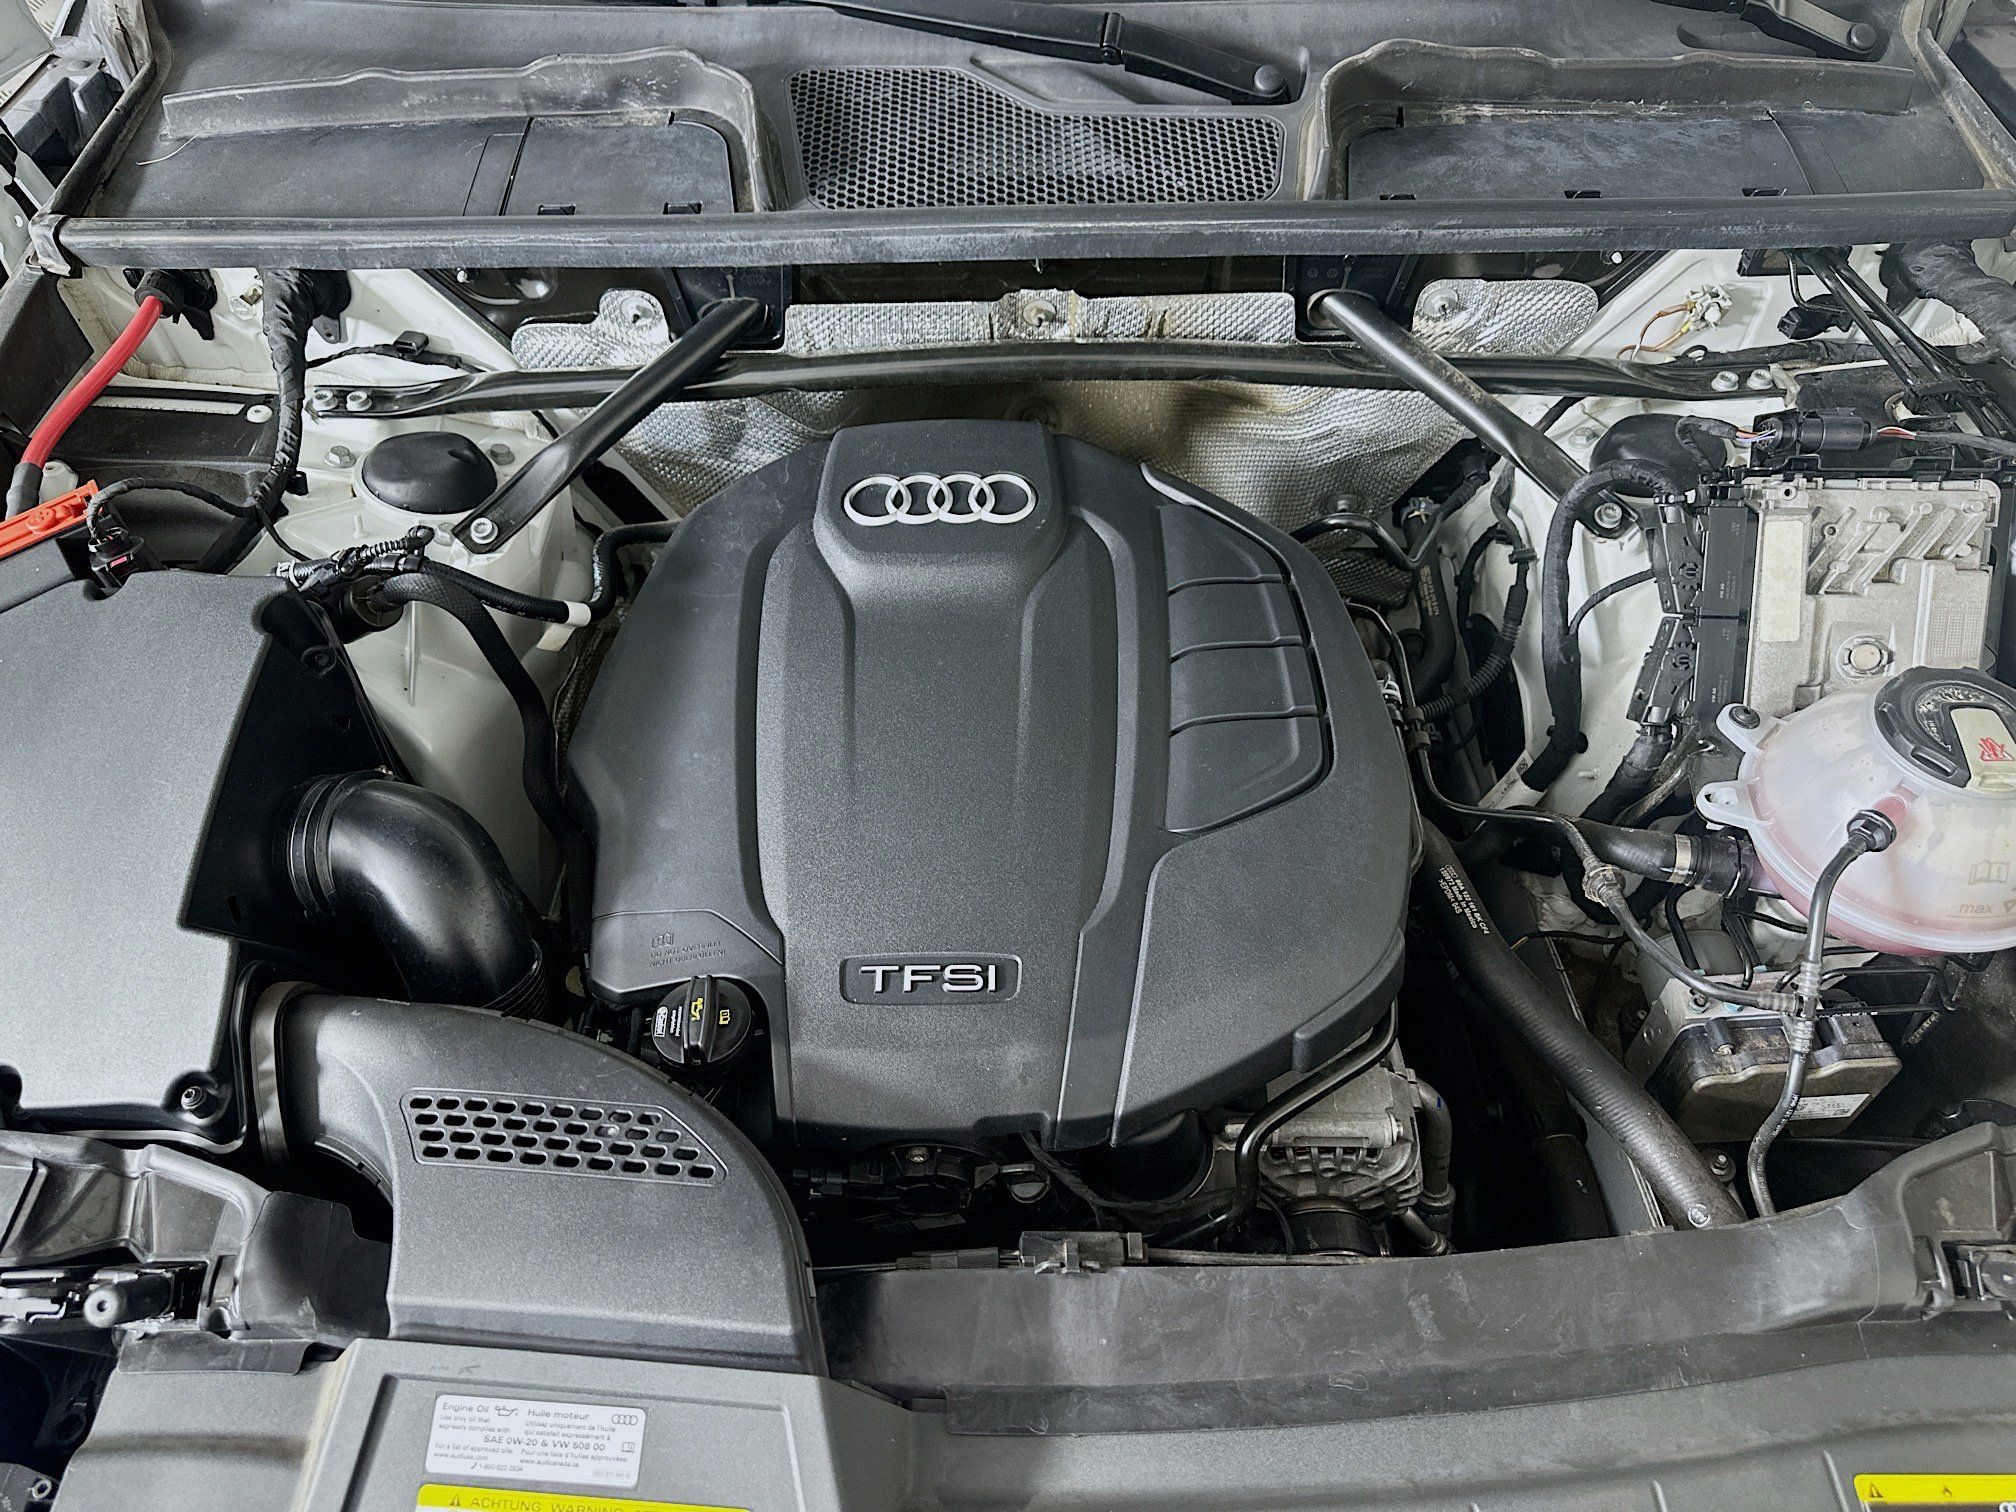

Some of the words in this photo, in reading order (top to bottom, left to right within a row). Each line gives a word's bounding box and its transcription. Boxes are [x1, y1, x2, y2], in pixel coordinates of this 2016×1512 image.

[1451, 885, 1464, 901] Made
[1464, 907, 1478, 929] Mexico
[1958, 902, 1993, 914] max
[650, 951, 662, 959] DO
[665, 947, 681, 956] NOT
[650, 958, 673, 968] NICHT
[859, 964, 997, 994] TFSI
[442, 1402, 474, 1413] Engine
[476, 1404, 490, 1413] Oil
[527, 1408, 551, 1418] Huile
[553, 1410, 590, 1420] moteur
[439, 1423, 467, 1431] expressly
[468, 1425, 496, 1433] complies
[525, 1420, 547, 1428] Utilisez
[549, 1421, 587, 1431] uniquement
[536, 1429, 560, 1437] satisfait
[483, 1434, 504, 1444] SAE
[506, 1436, 538, 1447] 0W-20
[540, 1438, 549, 1447] &
[552, 1439, 571, 1449] VW
[572, 1441, 591, 1450] 508
[593, 1442, 606, 1451] 00
[470, 1445, 500, 1453] approved
[521, 1448, 535, 1456] Pour
[470, 1496, 542, 1512] ACHTUNG
